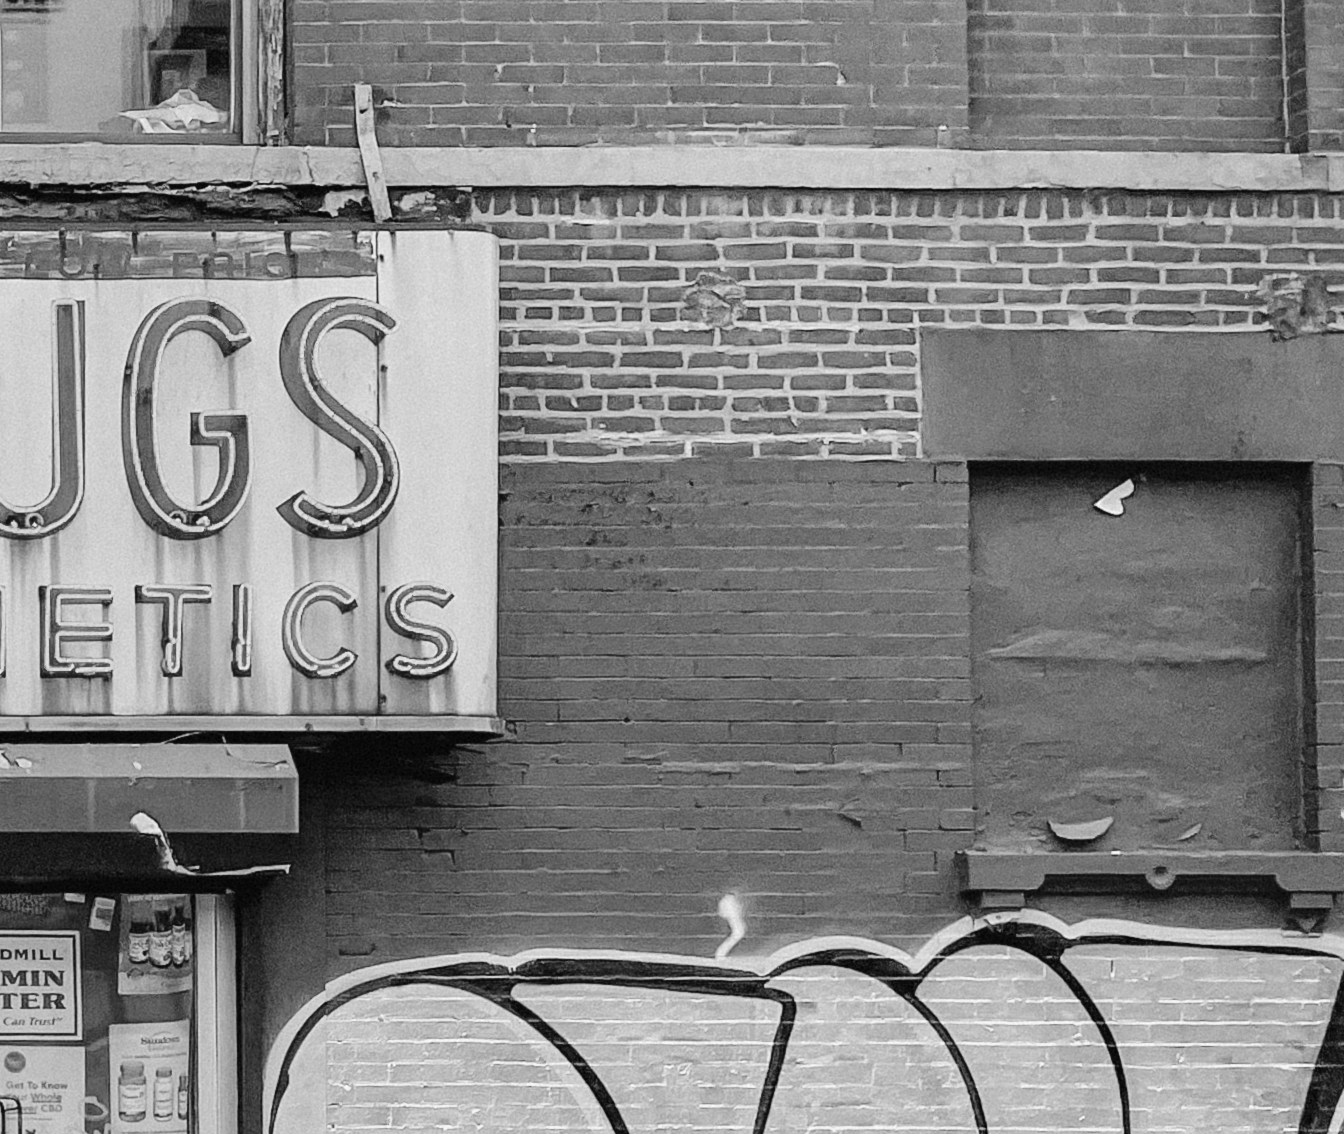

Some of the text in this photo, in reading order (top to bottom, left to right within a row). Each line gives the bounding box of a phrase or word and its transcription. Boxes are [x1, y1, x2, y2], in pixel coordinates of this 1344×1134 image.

[3, 1016, 26, 1026] Can
[5, 1080, 69, 1090] Get To Know
